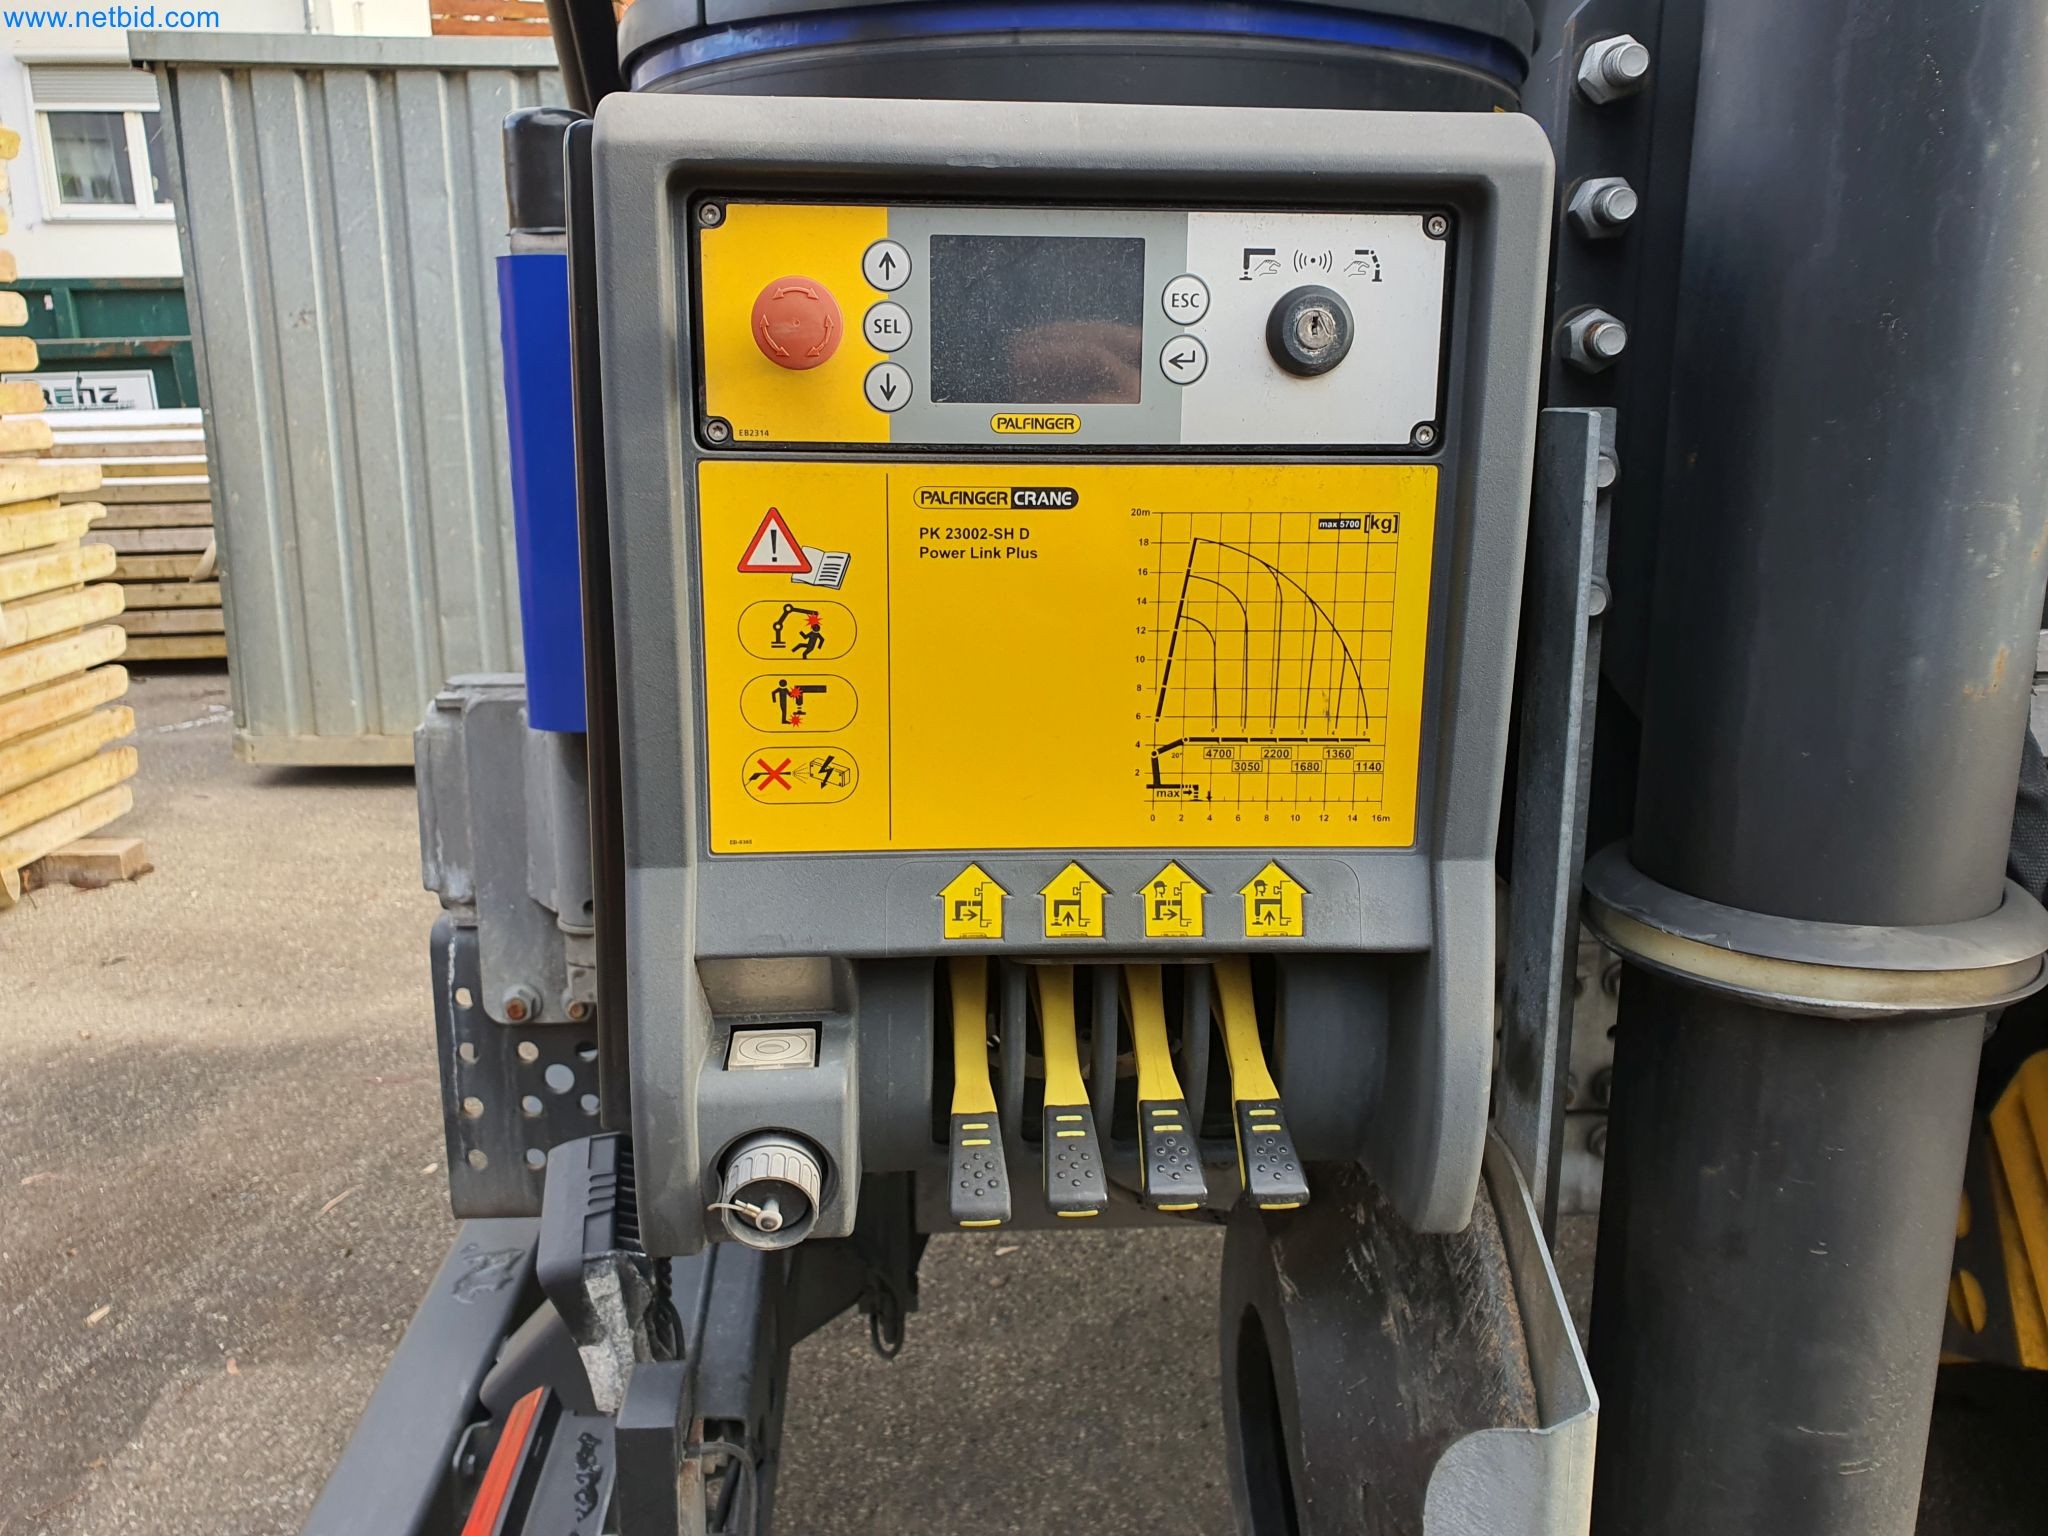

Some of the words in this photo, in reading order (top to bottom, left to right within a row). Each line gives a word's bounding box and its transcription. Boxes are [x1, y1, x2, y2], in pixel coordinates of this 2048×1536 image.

[1171, 293, 1200, 308] ESC
[874, 318, 902, 334] SEL
[997, 417, 1075, 430] PALFINGER
[920, 490, 1009, 505] PALFINGER
[1013, 491, 1072, 506] CRANE
[1131, 508, 1150, 516] 20m
[1340, 520, 1360, 528] 5700
[919, 527, 941, 540] PK
[945, 527, 1014, 540] 23002-SH
[1019, 528, 1030, 540] D
[1139, 538, 1149, 546] 18
[919, 546, 966, 559] Power
[970, 547, 1001, 559] Link
[1006, 547, 1038, 559] Plus
[1138, 568, 1148, 576] 16
[1137, 597, 1147, 605] 14
[1136, 626, 1146, 634] 12
[1135, 655, 1145, 663] 10
[1136, 684, 1142, 692] 8
[1135, 712, 1141, 720] 6
[1205, 749, 1233, 758] 4700
[1263, 749, 1290, 759] 2200
[1325, 750, 1352, 758] 1360
[1234, 762, 1261, 771] 3050
[1294, 762, 1321, 771] 1680
[1355, 763, 1382, 771] 1140
[1156, 789, 1181, 798] max
[1150, 814, 1156, 822] 0
[1178, 814, 1184, 822] 2
[1207, 814, 1213, 822] 4
[1235, 814, 1241, 822] 6
[1264, 814, 1270, 822] 8
[1291, 814, 1301, 822] 10
[1319, 814, 1330, 822] 12
[1348, 814, 1359, 822] 14
[1372, 814, 1390, 822] 16m
